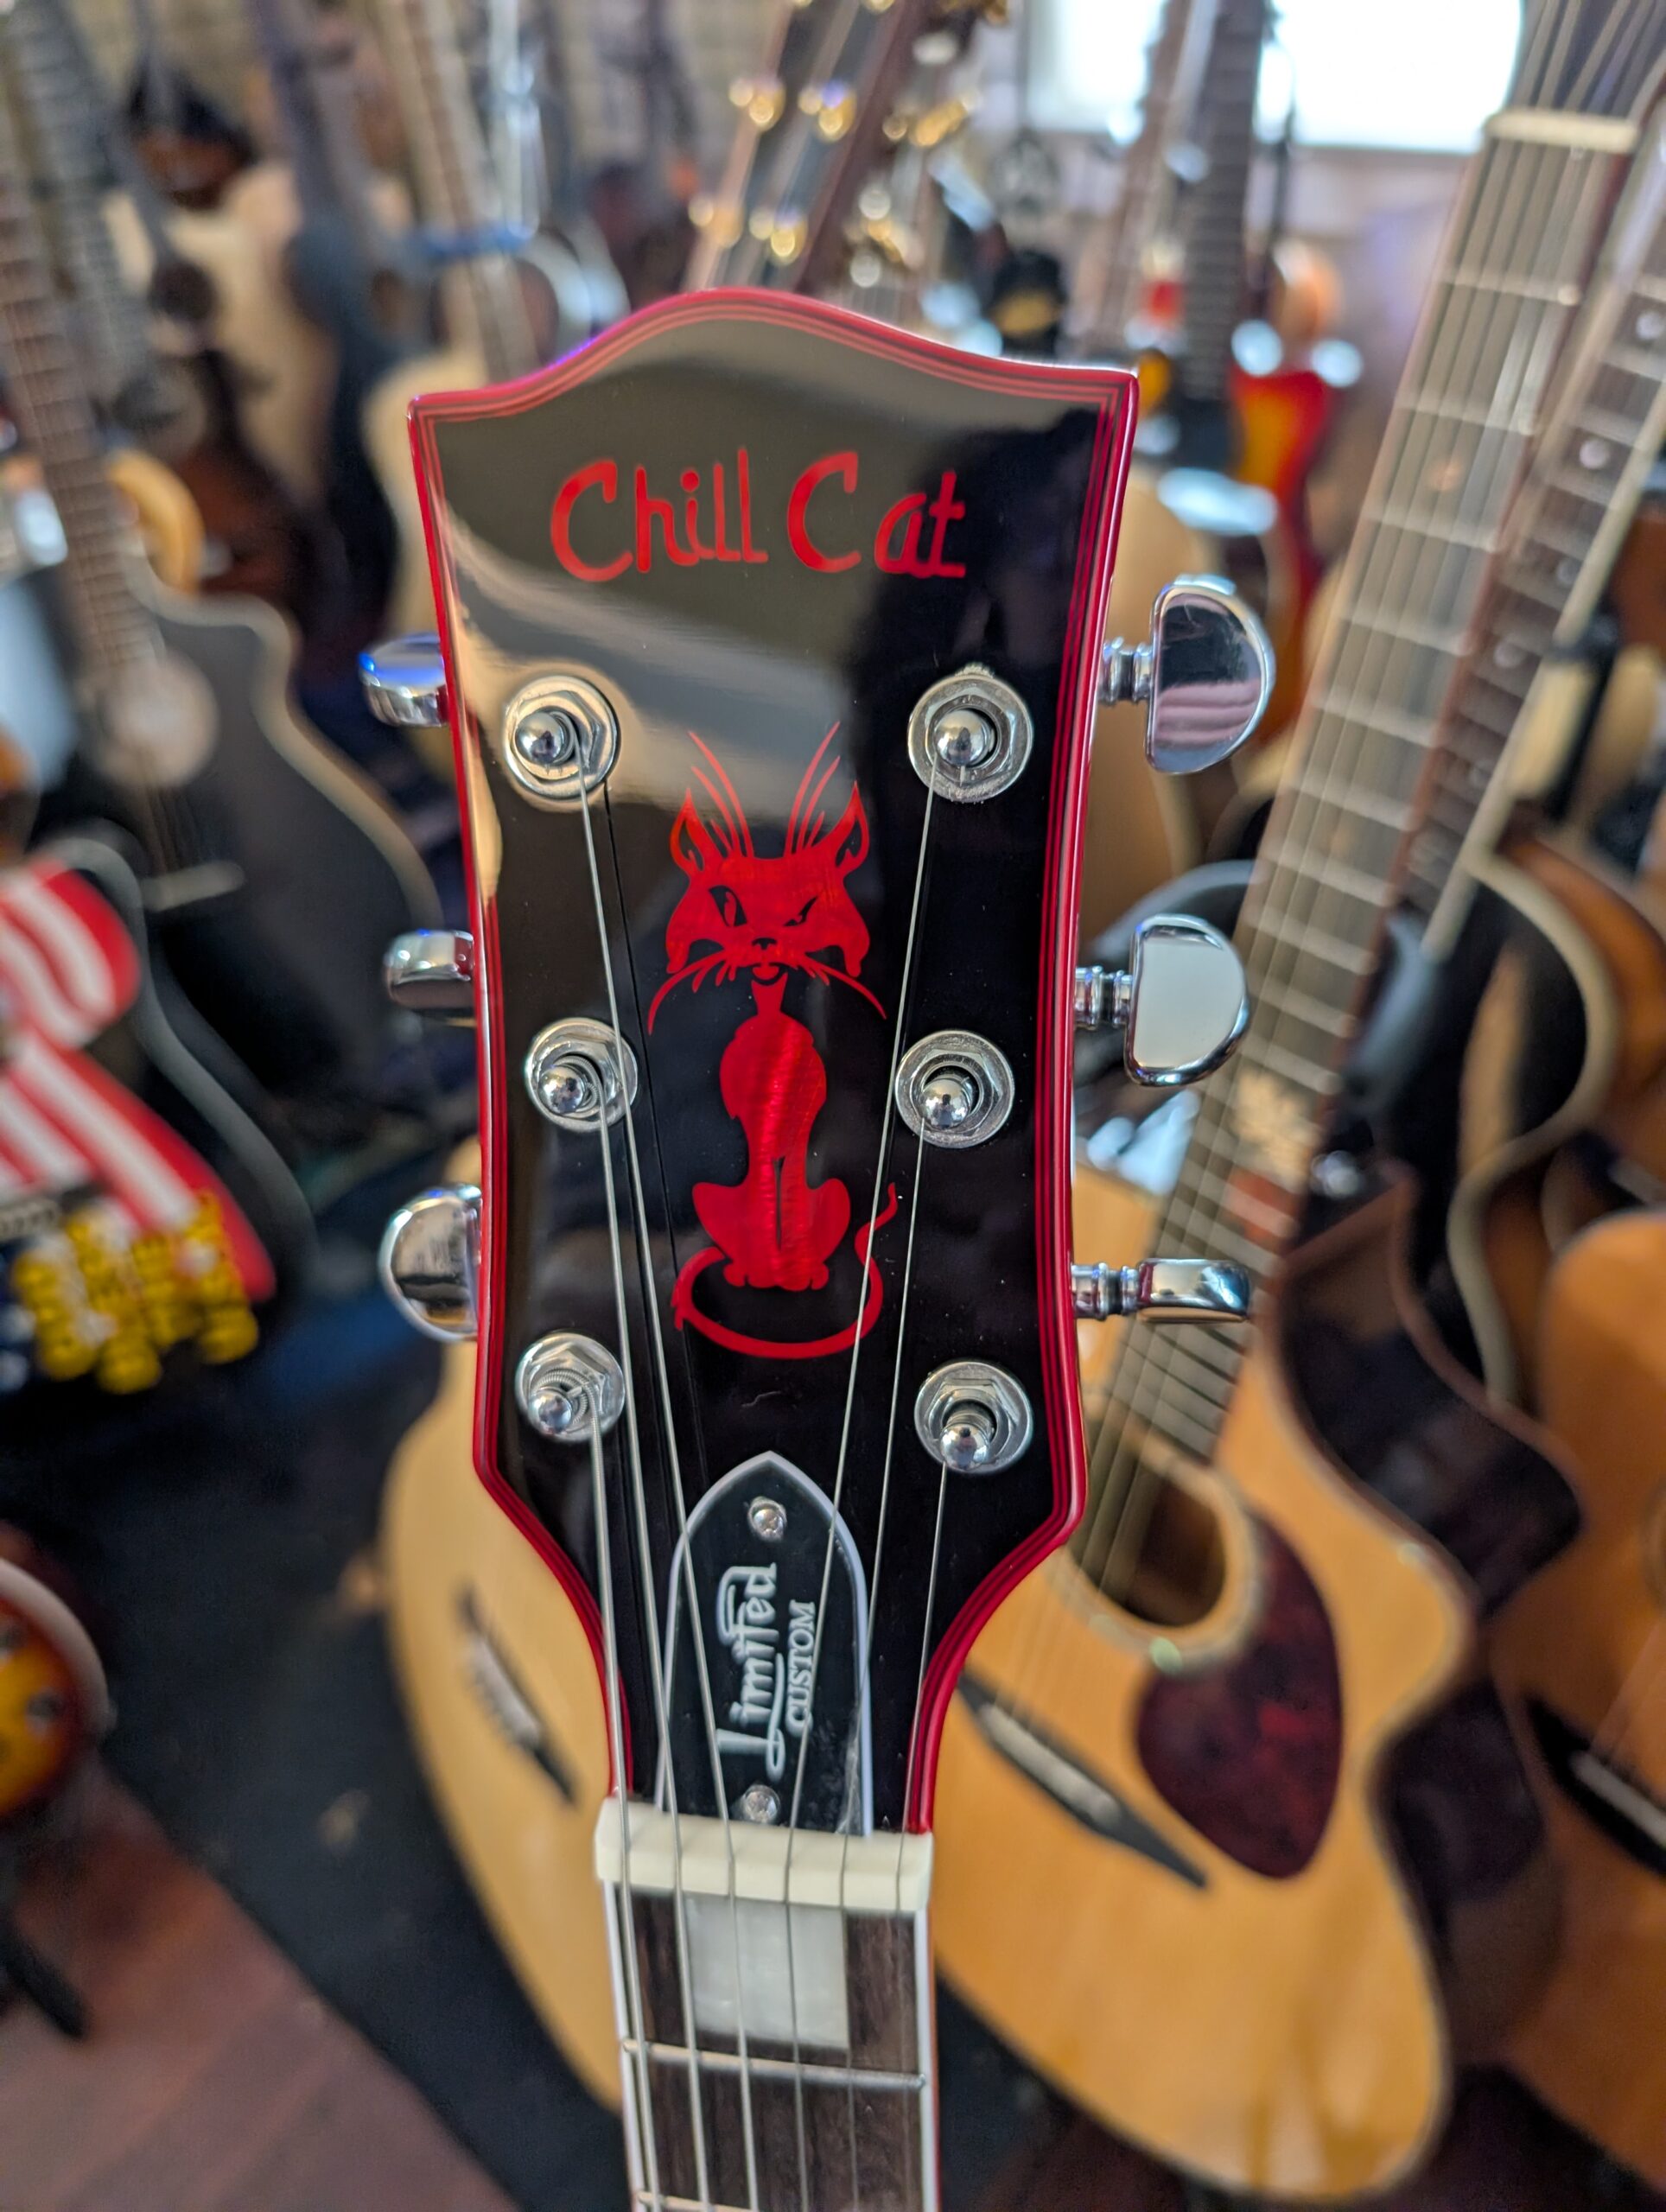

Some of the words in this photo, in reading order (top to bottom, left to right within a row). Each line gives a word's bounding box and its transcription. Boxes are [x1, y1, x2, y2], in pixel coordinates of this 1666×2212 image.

[550, 448, 768, 582] Chill
[787, 451, 966, 578] Cat
[715, 1562, 785, 1782] Limited
[785, 1599, 816, 1738] CUSTOM
